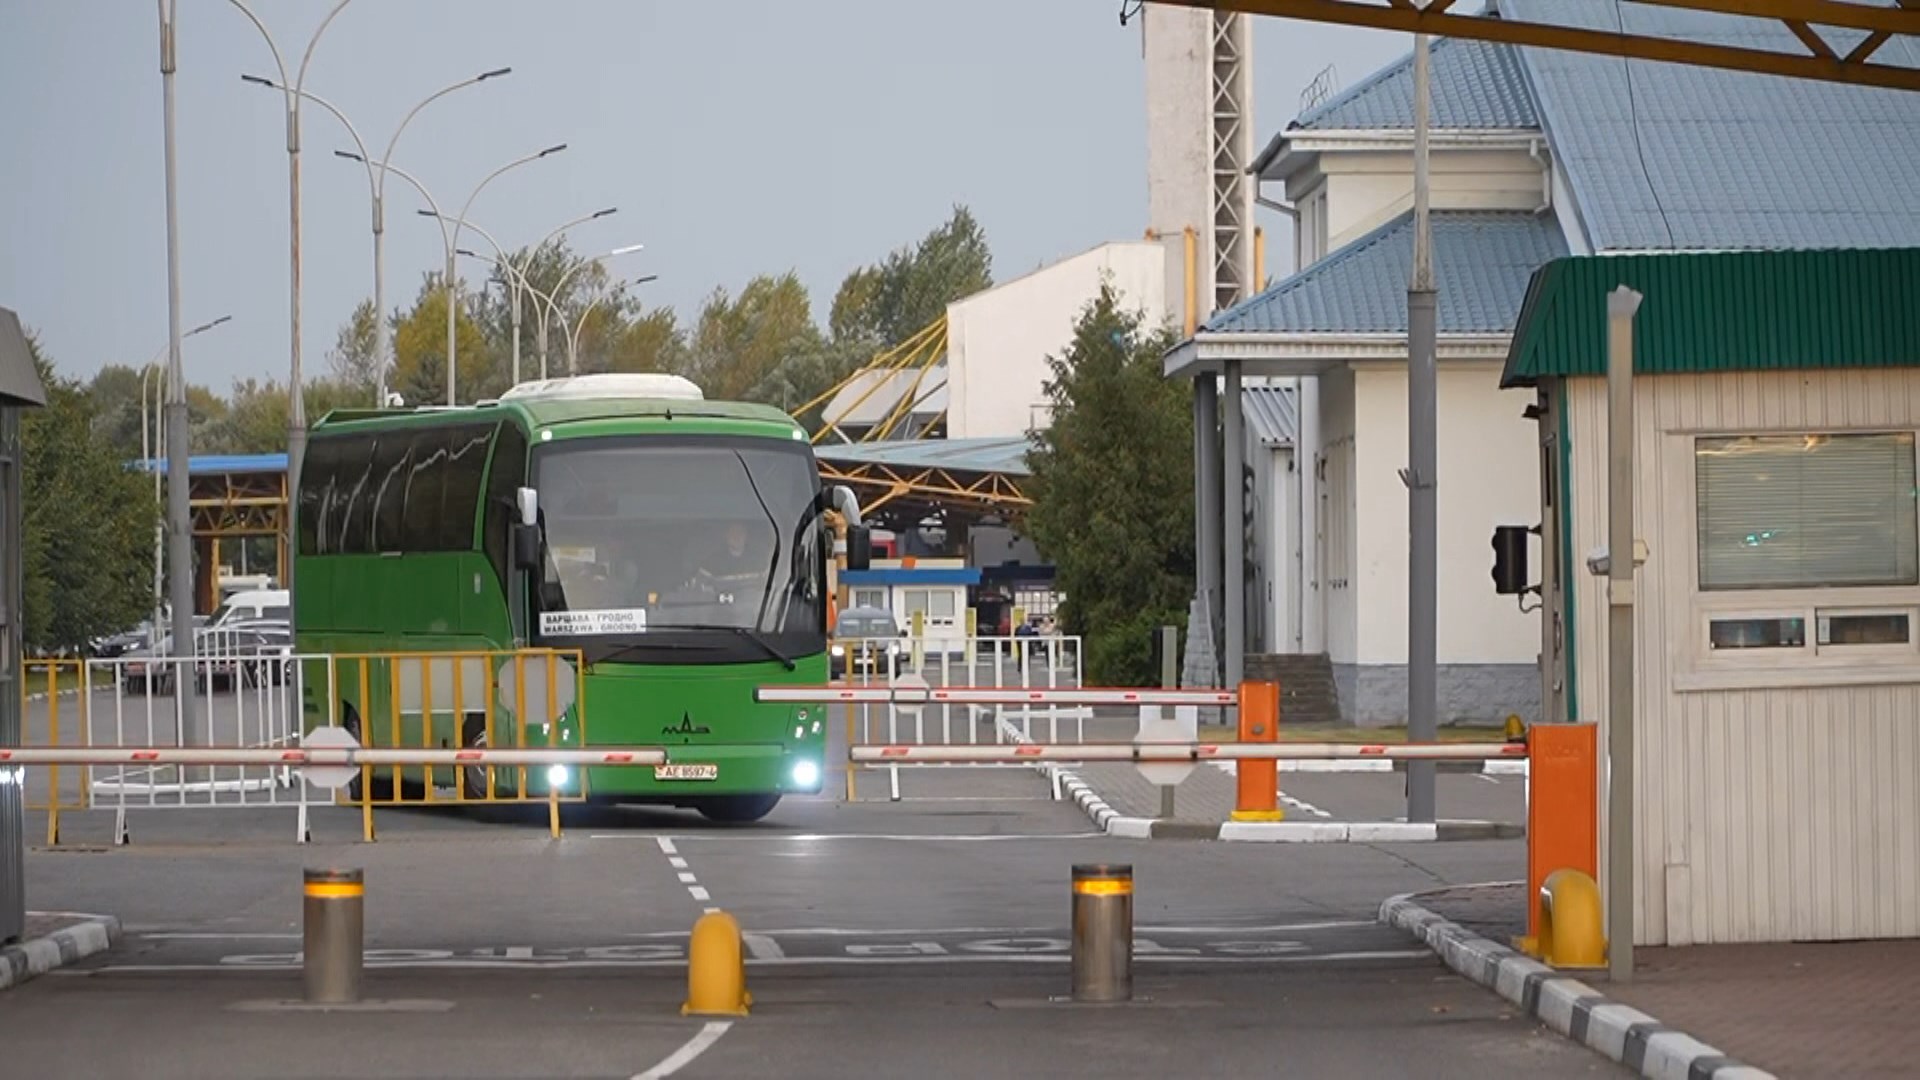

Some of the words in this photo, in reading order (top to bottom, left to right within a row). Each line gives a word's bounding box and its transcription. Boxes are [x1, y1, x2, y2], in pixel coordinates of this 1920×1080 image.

[546, 614, 589, 624] ВАРШАВА
[597, 613, 633, 623] ГРОДНО
[544, 624, 593, 633] WARSZAWA
